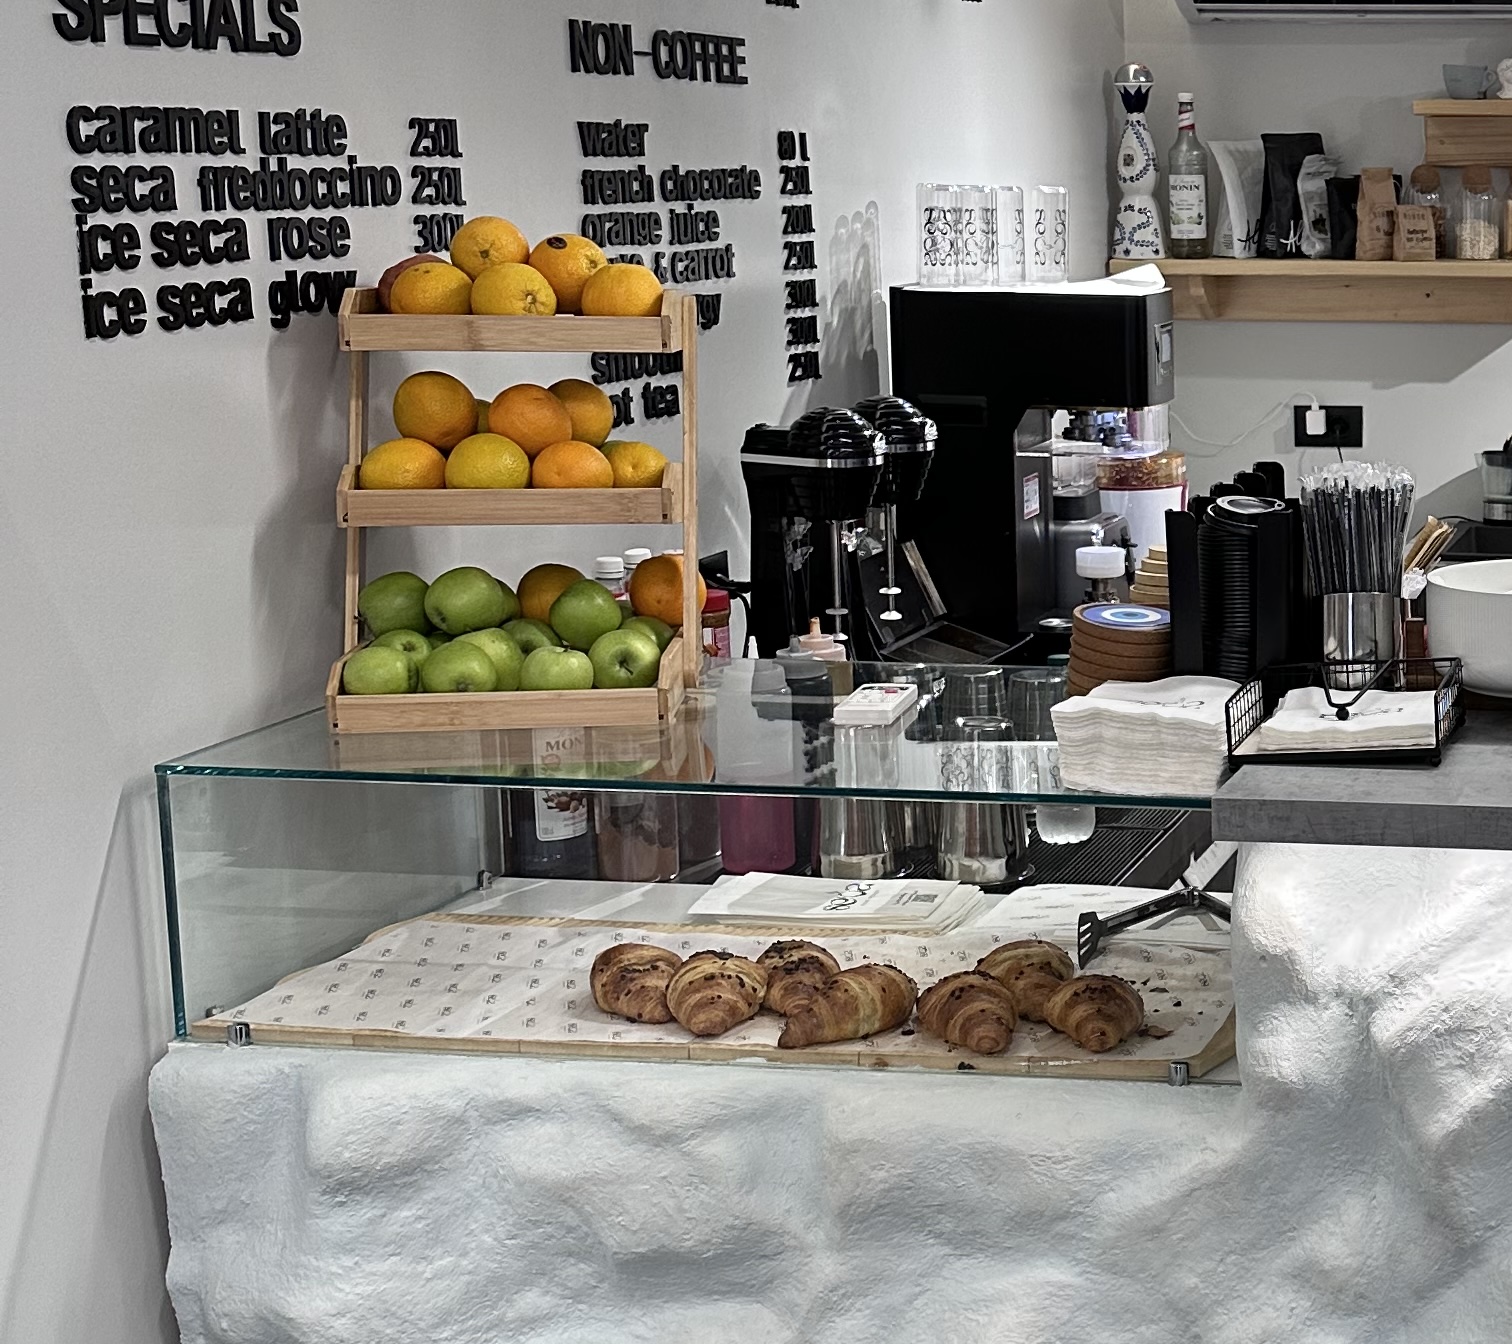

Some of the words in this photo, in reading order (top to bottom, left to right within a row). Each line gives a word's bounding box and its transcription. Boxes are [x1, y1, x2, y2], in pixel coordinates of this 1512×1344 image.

[568, 18, 749, 86] NON-COFFEE
[66, 105, 246, 155] caramel
[258, 108, 348, 156] latte
[577, 119, 649, 158] water
[71, 165, 178, 213] seca
[197, 155, 401, 211] freddoccino
[581, 164, 654, 206] french
[660, 164, 762, 203] chocolate
[76, 214, 141, 275] ice
[151, 218, 250, 267] seca
[267, 215, 351, 261] rose
[581, 210, 662, 246] orange
[669, 202, 720, 246] juice
[670, 242, 736, 283] carrot
[80, 278, 147, 339] ice
[157, 277, 254, 331] seca
[268, 270, 357, 328] glow
[641, 381, 681, 420] tea
